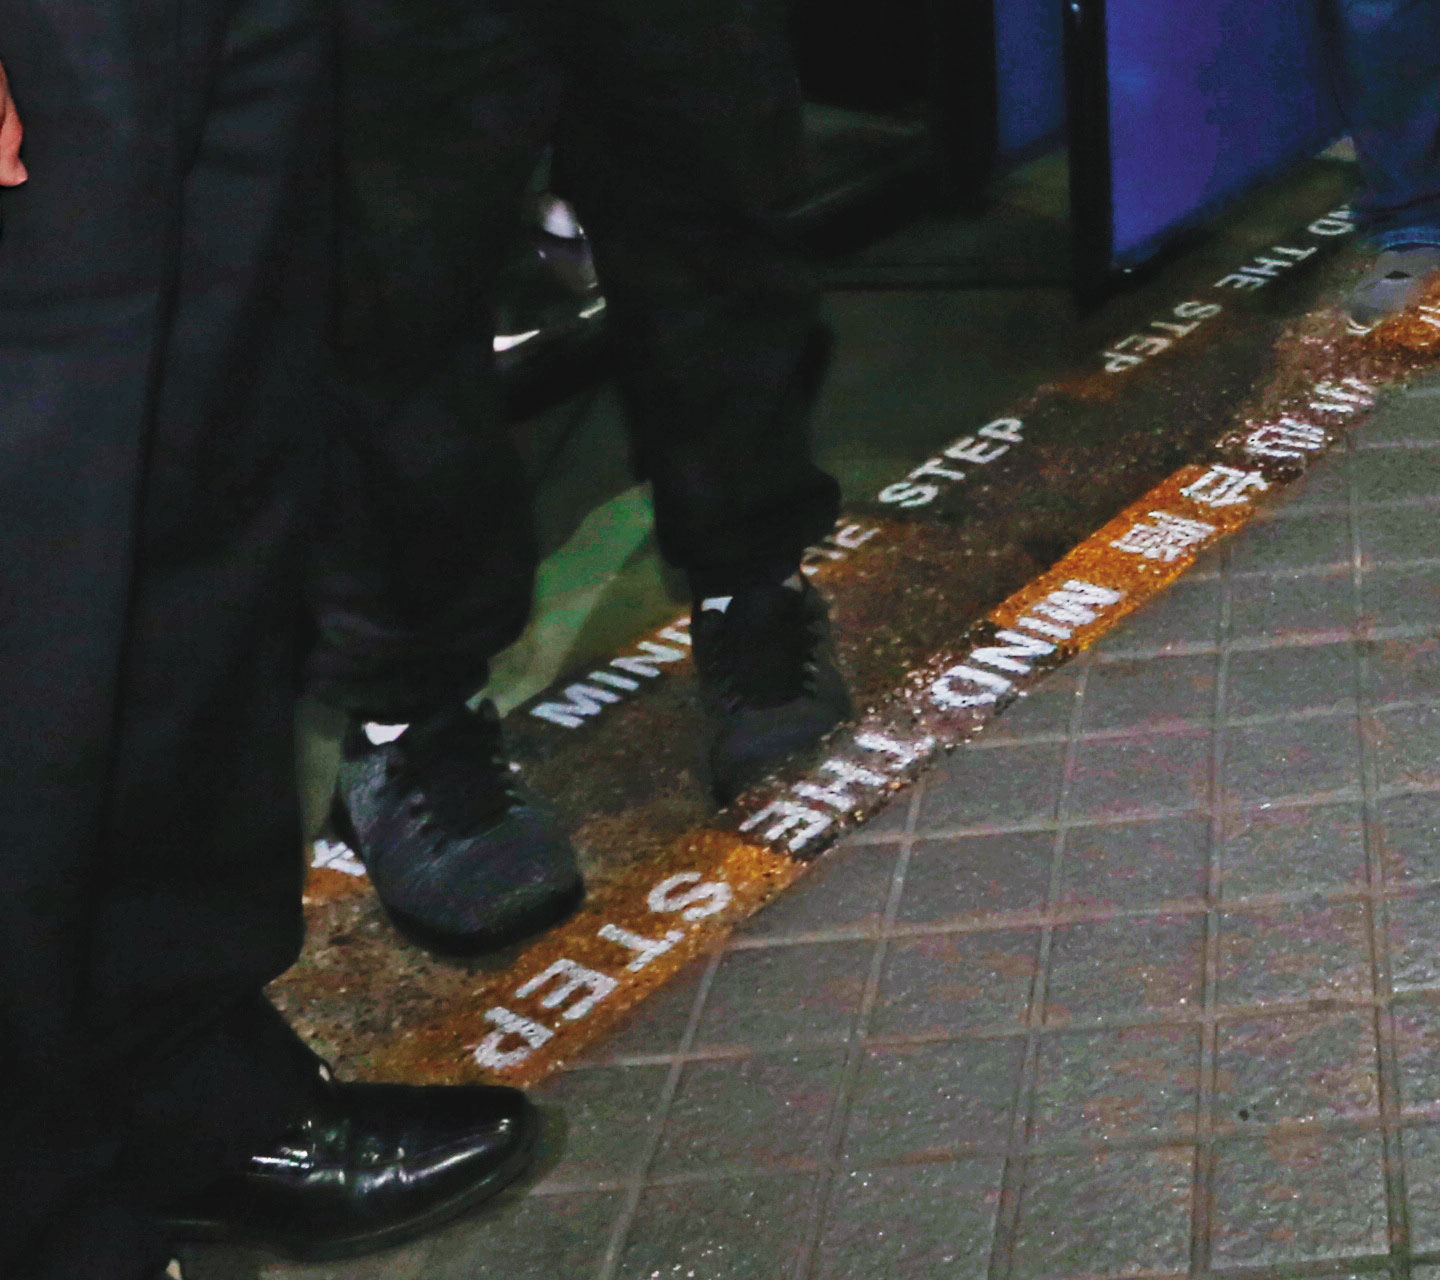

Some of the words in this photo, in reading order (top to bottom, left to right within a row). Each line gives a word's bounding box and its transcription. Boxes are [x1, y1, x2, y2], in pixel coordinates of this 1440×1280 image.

[1102, 299, 1222, 374] STEP
[877, 413, 1029, 510] STEP
[472, 868, 735, 1071] STEP
